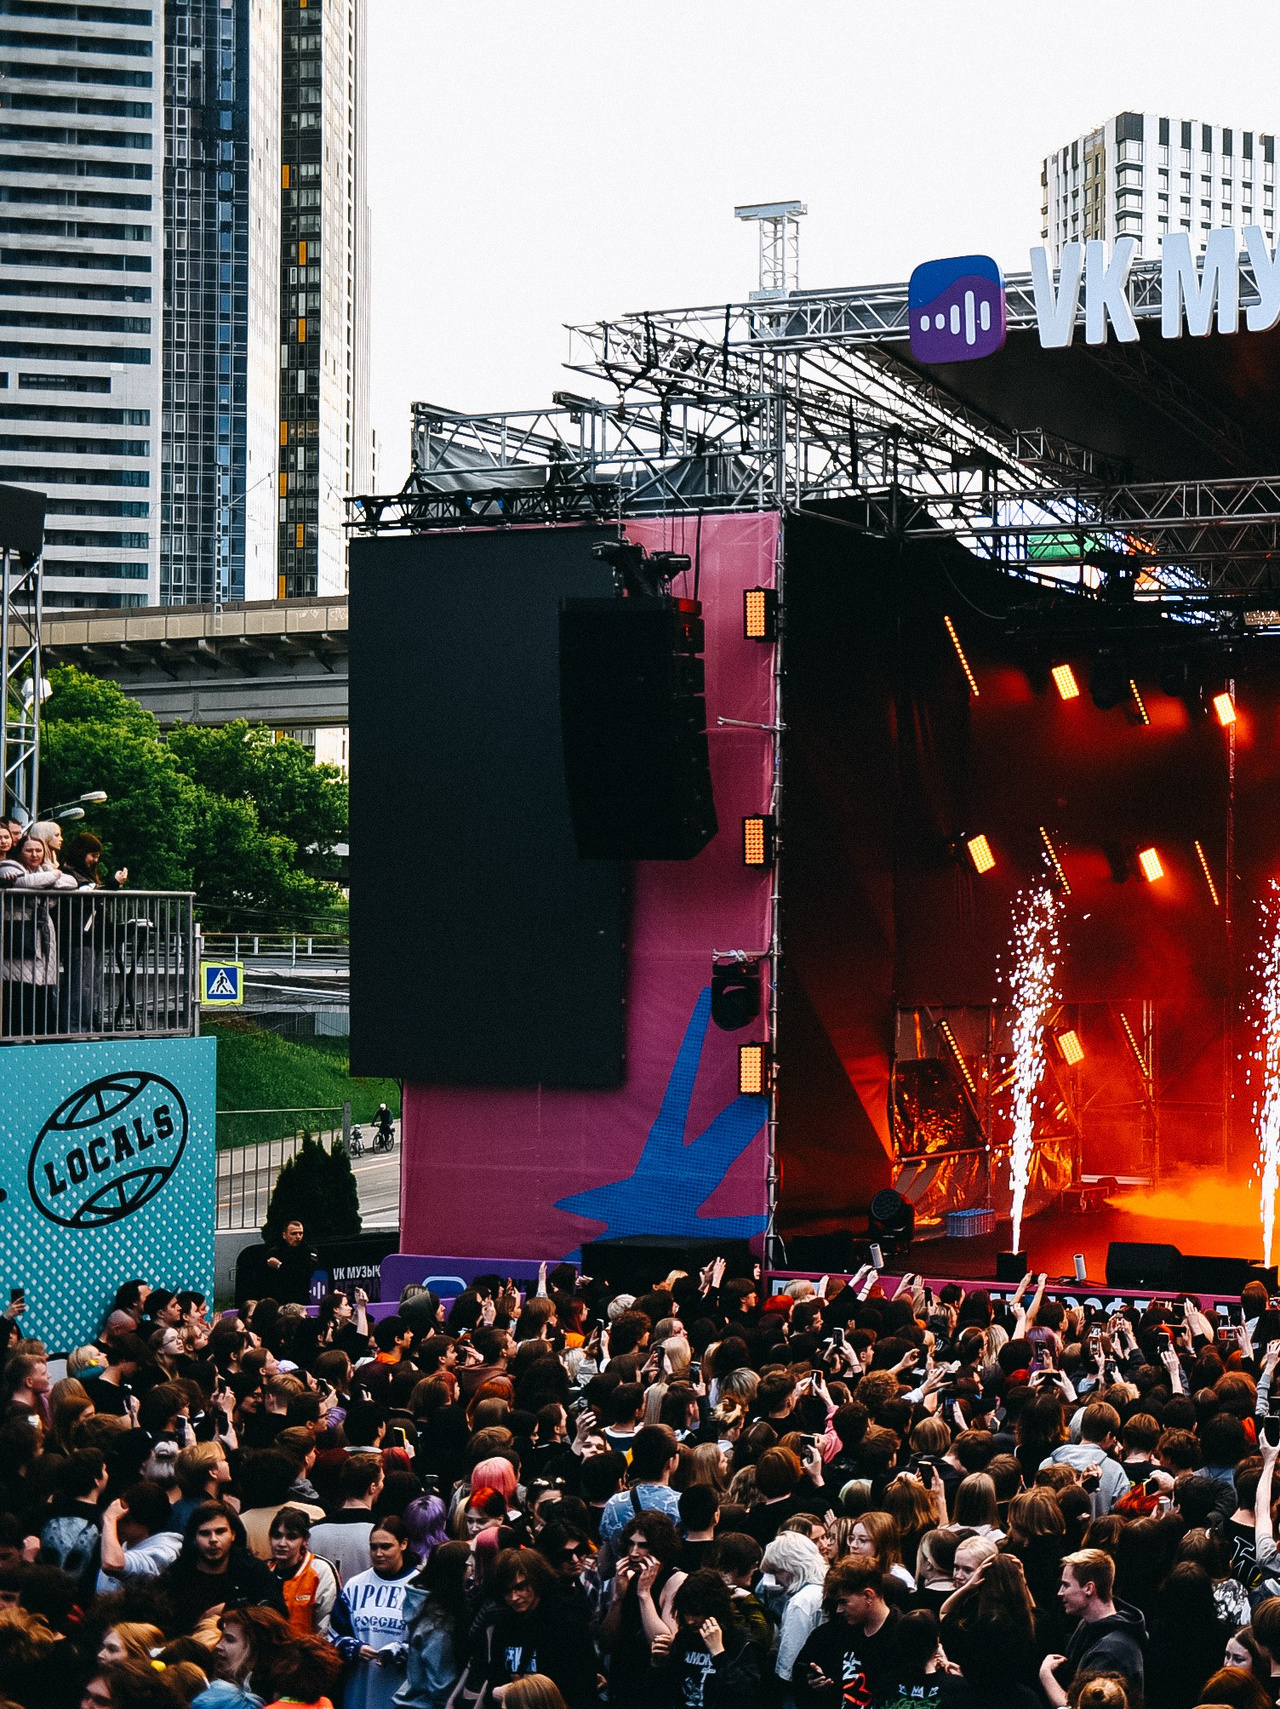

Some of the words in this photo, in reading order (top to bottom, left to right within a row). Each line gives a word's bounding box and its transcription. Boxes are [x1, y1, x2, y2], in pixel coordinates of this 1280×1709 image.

[1030, 237, 1140, 349] VK
[43, 1103, 175, 1198] LOCALS
[332, 1267, 346, 1281] VK
[353, 1616, 408, 1631] РОССИЯ
